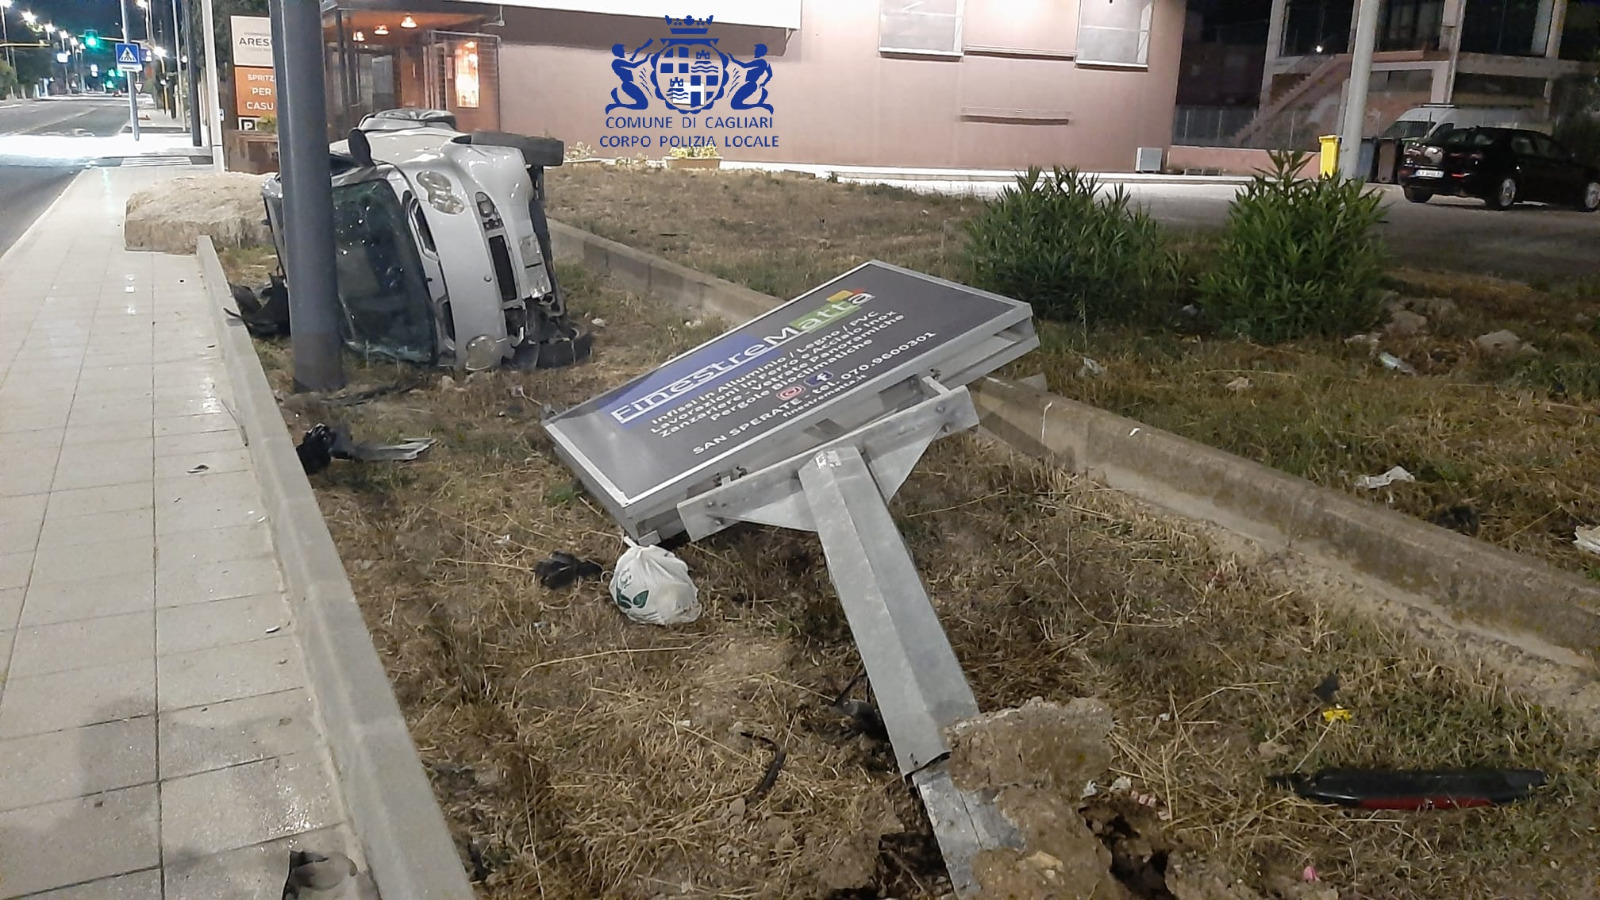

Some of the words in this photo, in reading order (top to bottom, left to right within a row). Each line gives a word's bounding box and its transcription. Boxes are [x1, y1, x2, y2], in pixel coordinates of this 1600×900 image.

[239, 38, 273, 47] ARES
[247, 74, 275, 82] SPRITZ
[246, 101, 274, 110] CASU
[252, 87, 272, 96] PER
[611, 293, 875, 423] FinestreMatta
[651, 387, 739, 433] Lavorazioni
[741, 380, 757, 388] in
[758, 360, 798, 379] Ferro
[813, 328, 862, 354] Acciaio
[864, 311, 896, 327] Inox
[652, 400, 697, 424] Infissi
[718, 358, 786, 392] Alluminio
[796, 331, 840, 353] Legno
[850, 311, 879, 327] PVC
[659, 395, 741, 437] Zanzariere
[751, 363, 808, 390] Vetrate
[809, 315, 903, 362] Panoramiche
[693, 435, 727, 454] SAN
[729, 398, 802, 436] SPERATE
[812, 381, 839, 393] tel.
[841, 333, 935, 379] 070.9600301
[710, 390, 769, 420] Pergole
[771, 340, 872, 390] Bioclimatiche
